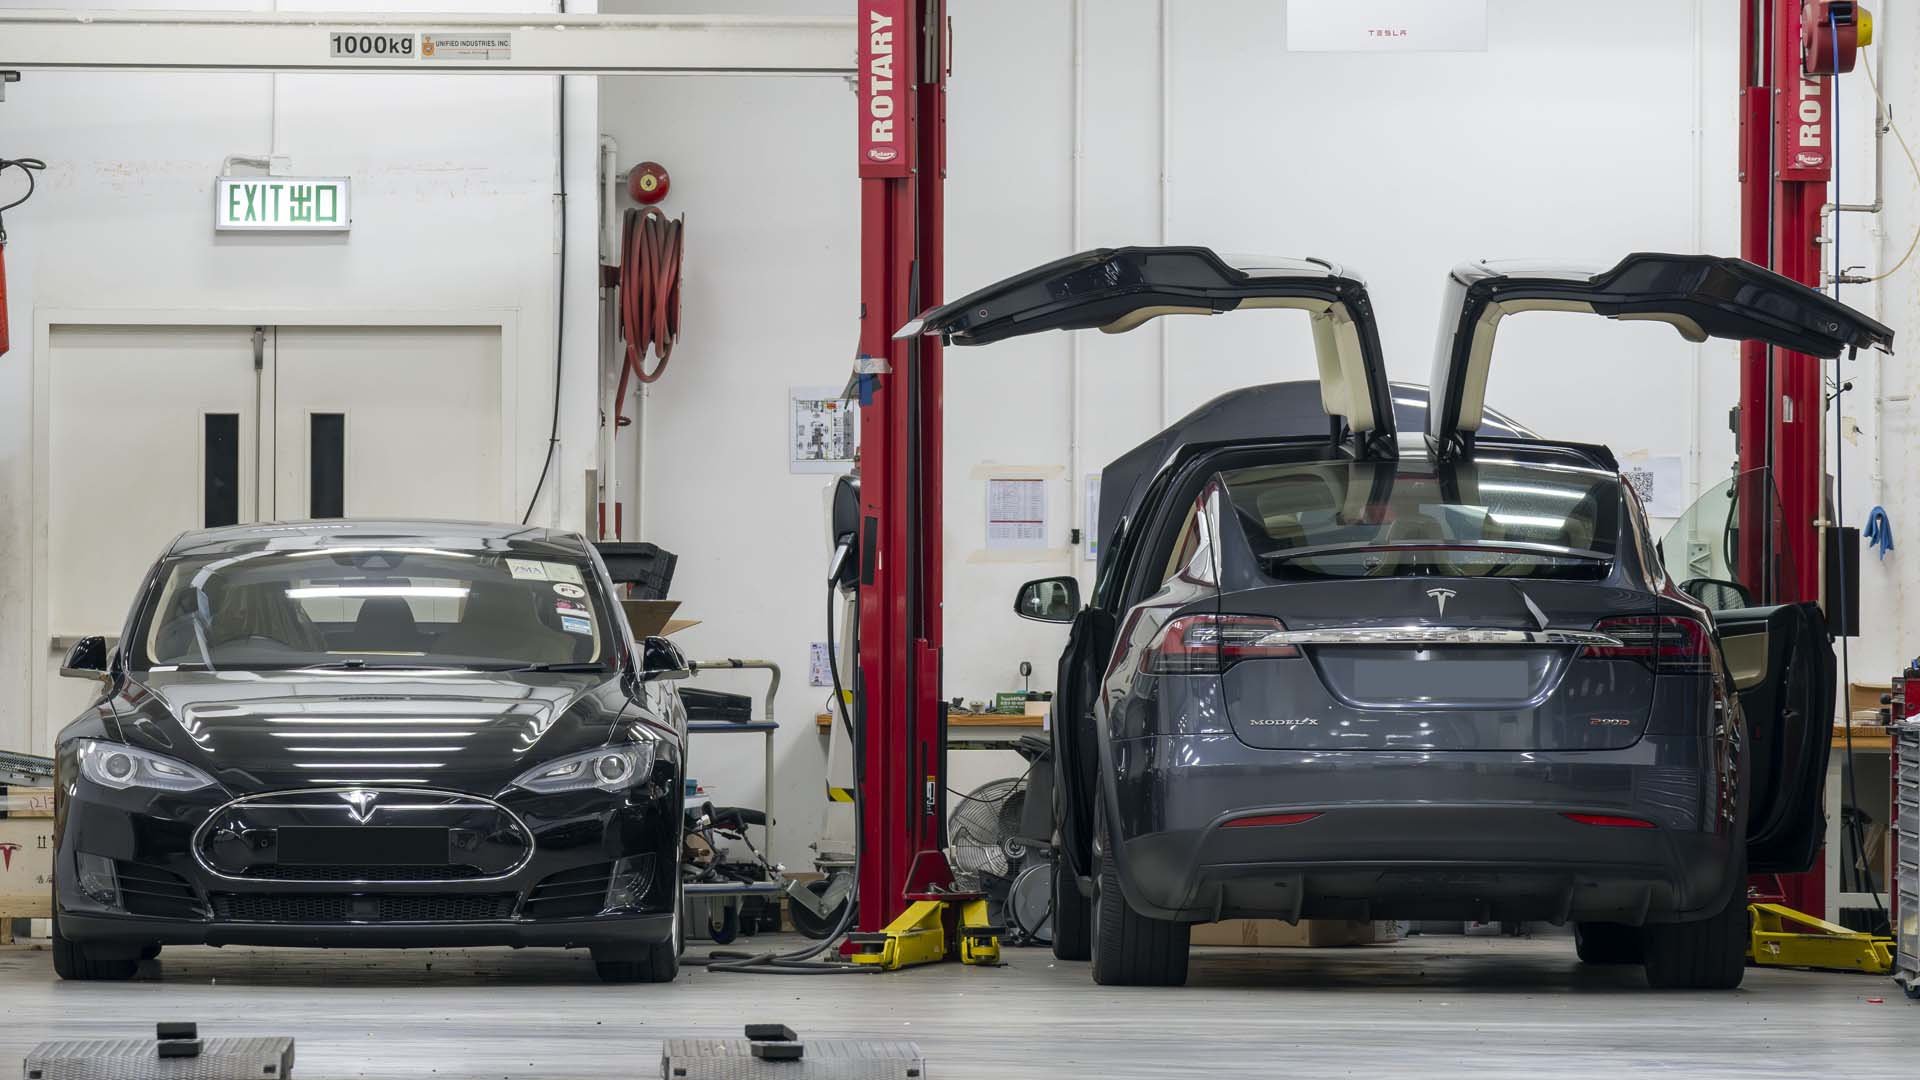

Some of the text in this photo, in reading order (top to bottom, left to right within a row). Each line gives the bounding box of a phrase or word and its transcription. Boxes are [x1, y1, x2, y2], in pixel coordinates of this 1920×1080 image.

[332, 36, 413, 54] 1000kg
[1368, 29, 1407, 37] TESLA
[870, 10, 894, 142] ROTARY
[229, 184, 338, 222] EXIT 出口
